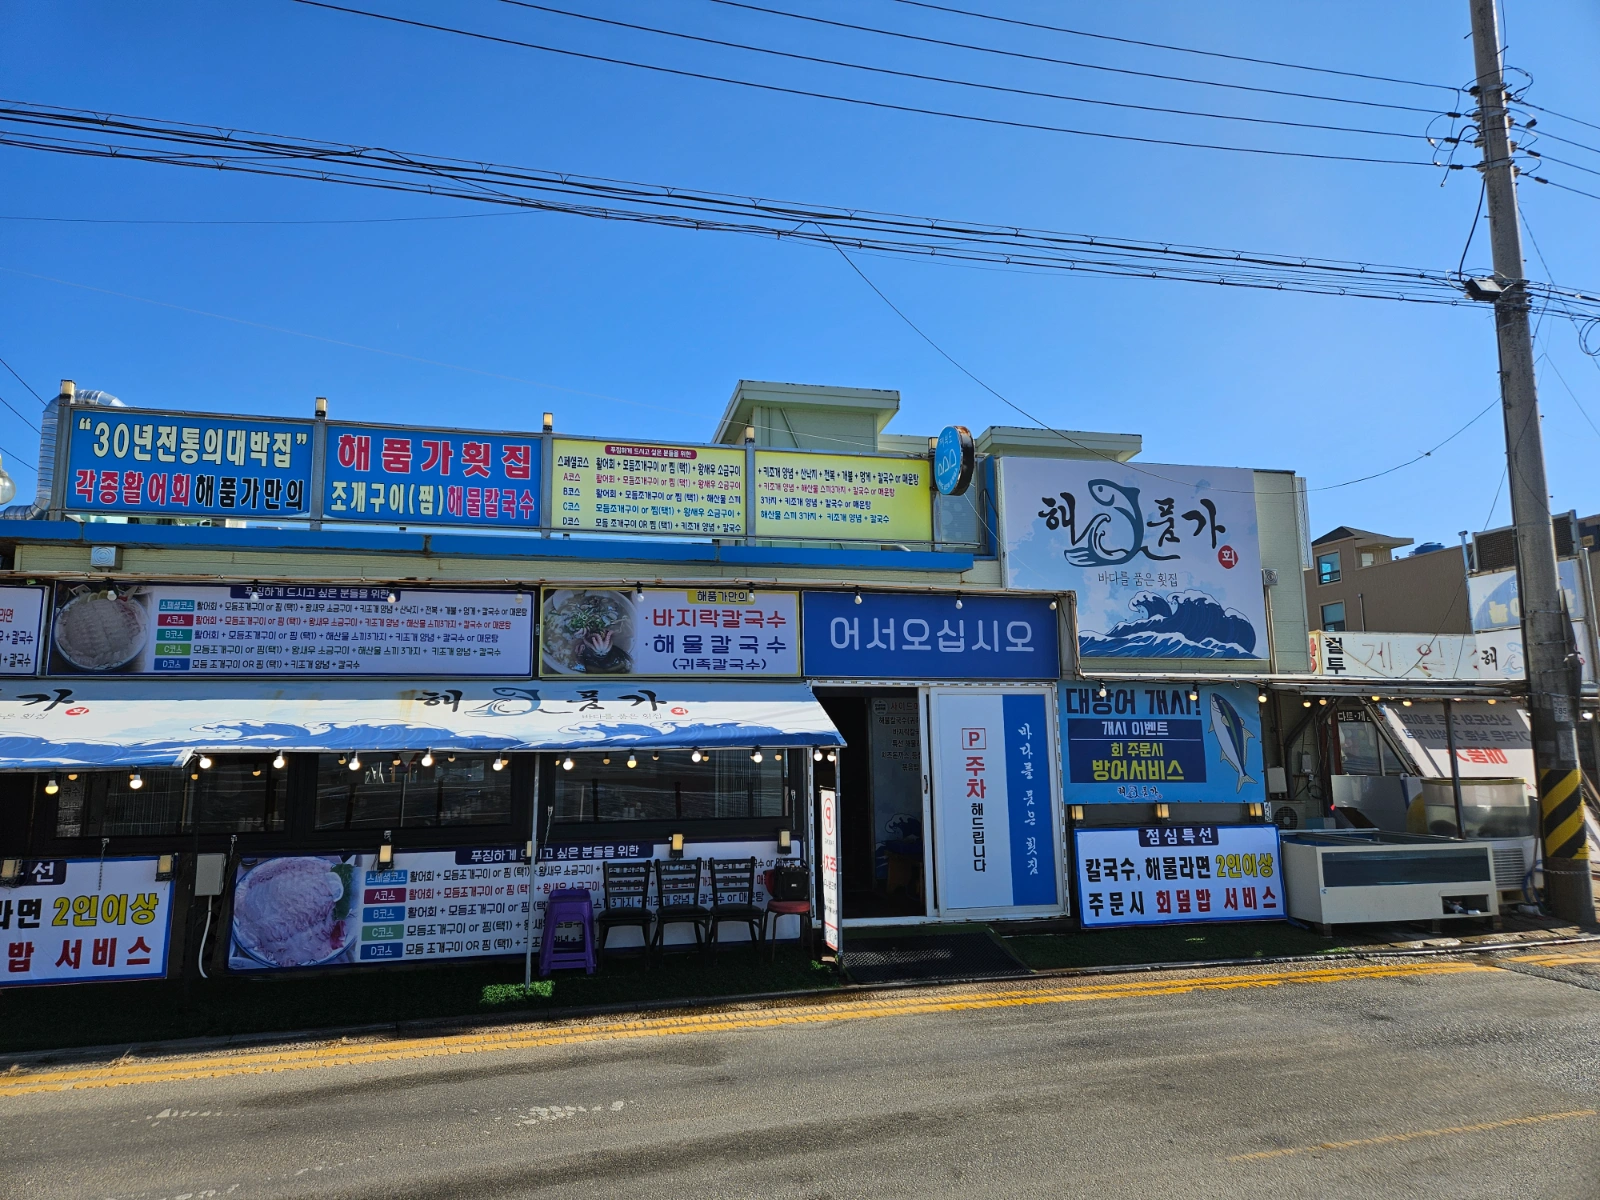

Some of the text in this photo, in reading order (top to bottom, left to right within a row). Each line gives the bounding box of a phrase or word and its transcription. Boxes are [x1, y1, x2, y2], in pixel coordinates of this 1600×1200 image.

[558, 455, 740, 476] 스페셜코스 활어회 모듬조개구이 왕새우 소금구이
[563, 473, 580, 482] A코스
[596, 474, 615, 484] 활어회
[698, 477, 715, 488] 왕새우
[718, 479, 740, 490] 소금구이
[763, 467, 780, 478] 키조개
[878, 472, 894, 484] 칼국수
[563, 487, 580, 496] B코스
[596, 489, 616, 498] 활어회
[707, 493, 726, 504] 해산물
[563, 502, 580, 511] C코스
[684, 506, 704, 517] 왕새우
[707, 508, 734, 518] 소금구이
[563, 516, 741, 533] D코스 키조개 칼국수
[1038, 492, 1226, 549] 해품가
[1098, 570, 1178, 587] 바다를 품은 횟집
[286, 587, 315, 597] 드시고
[318, 588, 337, 598] 싶은
[340, 589, 368, 599] 분들을
[371, 589, 390, 598] 위한
[197, 602, 217, 610] 활어회
[360, 605, 379, 613] 키조개
[400, 606, 418, 614] 산낙지
[196, 616, 217, 625] 활어회
[652, 608, 787, 629] 바지락칼국수
[12, 631, 33, 645] 칼국수
[194, 630, 219, 639] 활어회
[396, 633, 418, 642] 키조개
[443, 634, 465, 642] 칼국수
[830, 617, 1035, 652] 어서오십시오
[358, 646, 381, 655] 해산물
[432, 648, 454, 656] 키조개
[479, 648, 501, 657] 칼국수
[653, 634, 787, 654] 해물칼국수
[10, 653, 31, 667] 칼국수
[163, 660, 360, 670] D코스 키조개 칼국수
[672, 658, 767, 671] (귀족칼국수)
[1066, 688, 1136, 715] 대방어
[1102, 721, 1169, 736] 개시 이벤트
[969, 732, 980, 746] P
[1111, 742, 1164, 757] 회 주문시
[1092, 760, 1184, 781] 방어서비스
[966, 756, 986, 872] 주차 해드립니다
[1146, 828, 1213, 846] 점심특선
[471, 850, 517, 862] 푸짐하게
[557, 847, 578, 858] 싶은
[582, 847, 614, 857] 분들을
[617, 845, 640, 856] 위한
[410, 870, 434, 882] 활어회
[1086, 853, 1274, 882] 칼국수, 해물라면 2인이상
[374, 891, 396, 900] A코스
[409, 888, 434, 900] 활어회
[1088, 886, 1277, 917] 주문시 회덮밥 서비스
[52, 893, 159, 927] 2인이상
[373, 909, 395, 919] B코스
[408, 907, 437, 918] 활어회
[372, 928, 394, 938] C코스
[55, 936, 152, 969] 서비스
[371, 946, 392, 956] D코스
